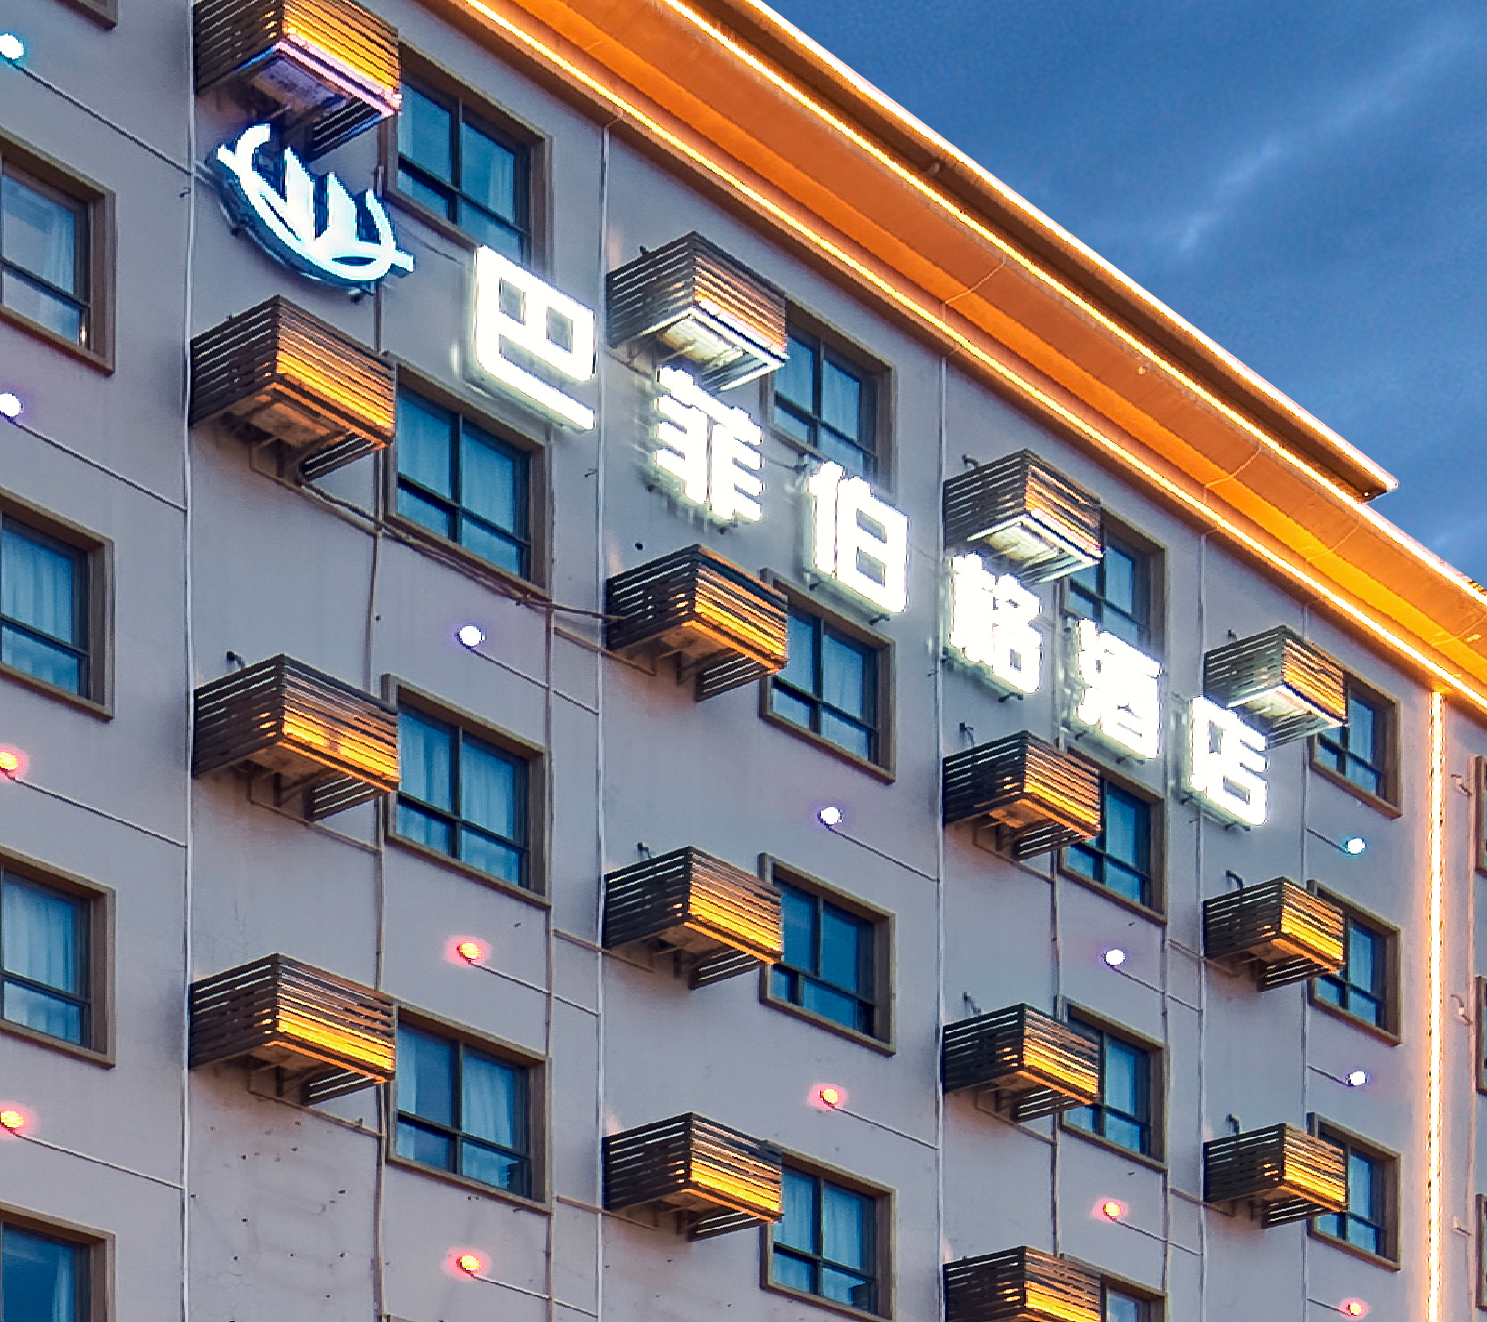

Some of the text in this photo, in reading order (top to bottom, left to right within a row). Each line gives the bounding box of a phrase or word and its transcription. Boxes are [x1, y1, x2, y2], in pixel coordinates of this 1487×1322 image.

[473, 244, 1269, 827] 巴菲伯格酒店
